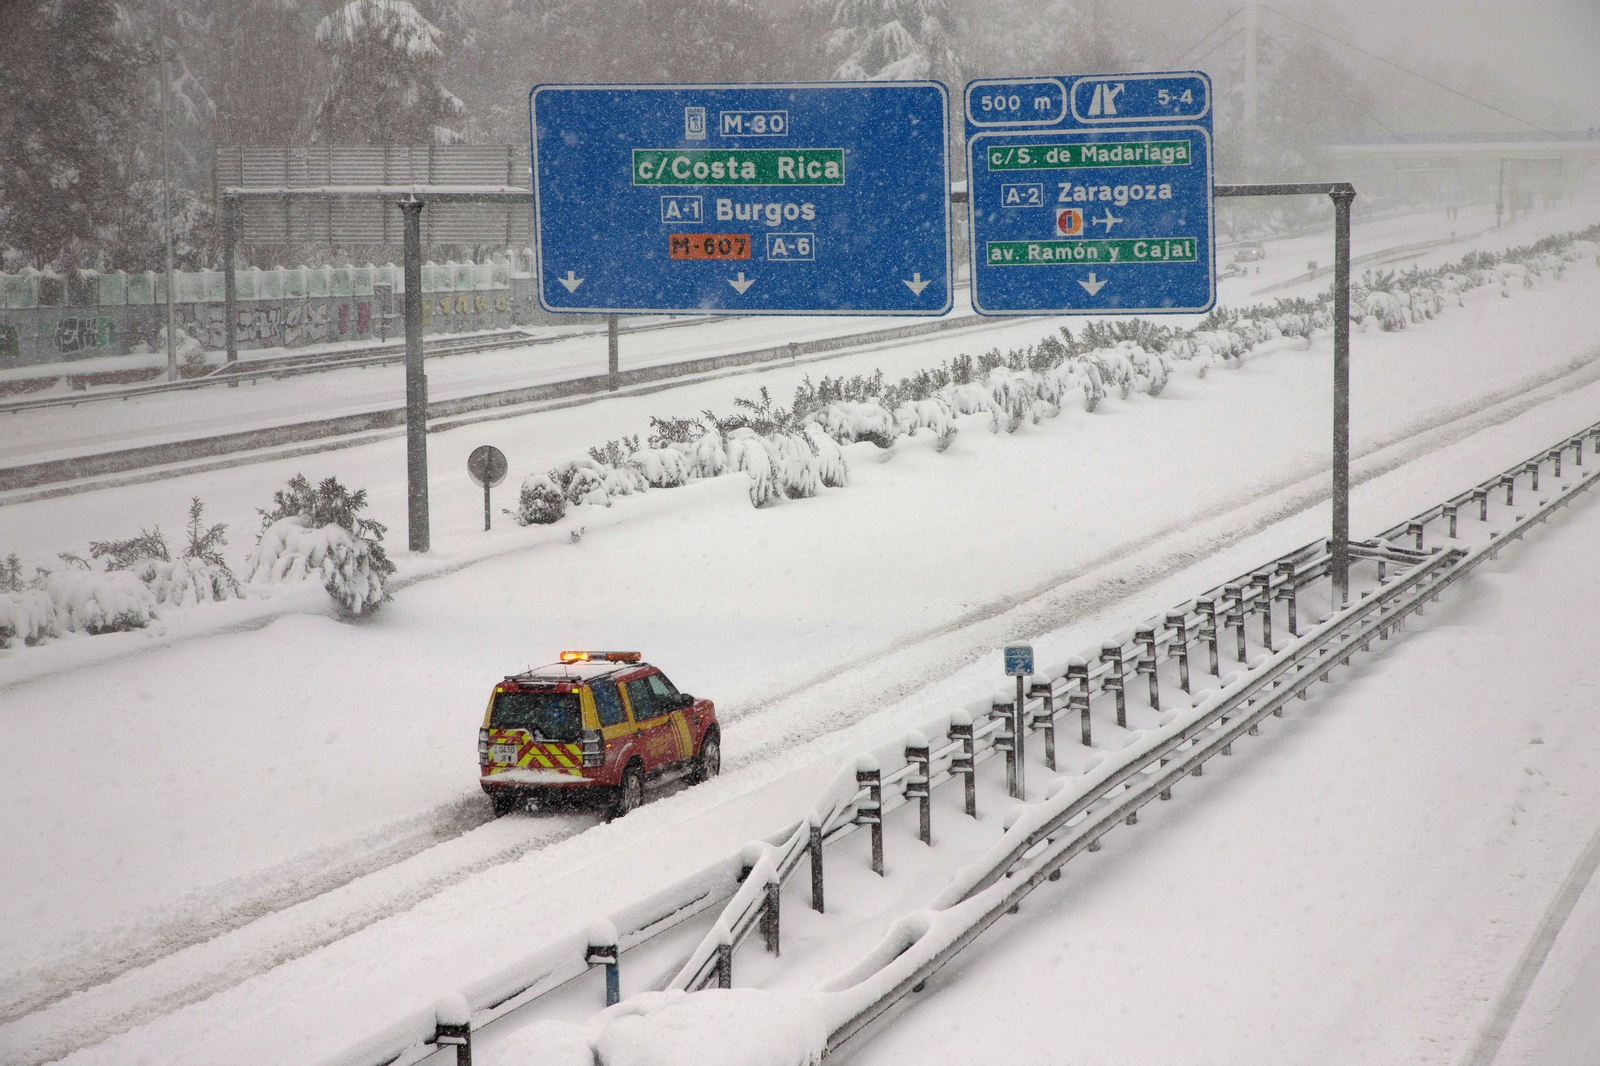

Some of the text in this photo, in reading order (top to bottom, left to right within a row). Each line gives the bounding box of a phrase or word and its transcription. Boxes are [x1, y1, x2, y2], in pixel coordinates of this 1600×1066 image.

[981, 95, 1050, 111] 500 m
[1157, 89, 1193, 105] 5-4
[724, 115, 784, 133] M-30
[991, 145, 1187, 165] c/S. de Madariaga
[638, 156, 840, 180] c/Costa Rica
[1006, 183, 1172, 206] A-2 Zaragoza
[666, 199, 816, 226] A-1 Burgos
[672, 237, 810, 255] M-607 A-6
[991, 242, 1191, 261] av. Ramón y Cajal
[499, 746, 515, 754] 0410
